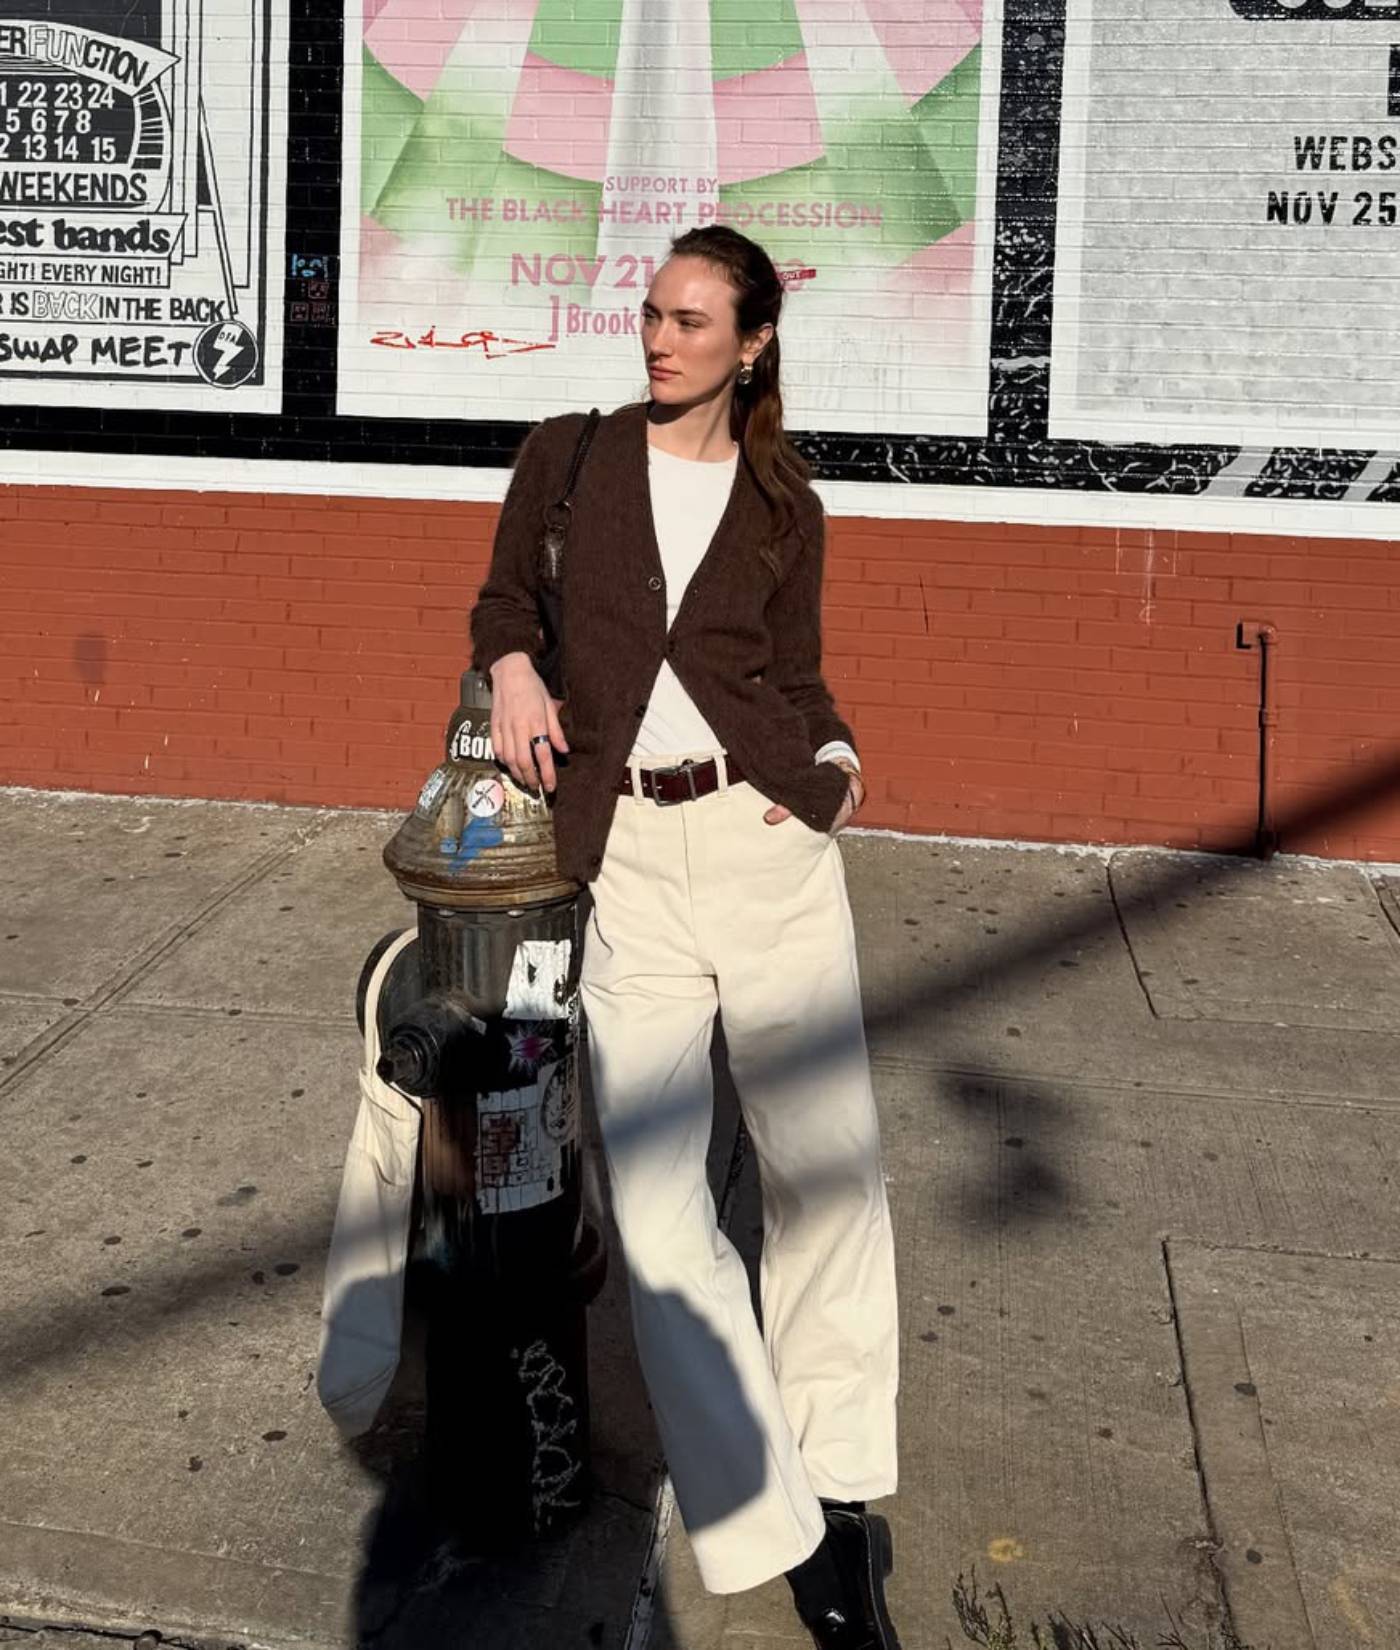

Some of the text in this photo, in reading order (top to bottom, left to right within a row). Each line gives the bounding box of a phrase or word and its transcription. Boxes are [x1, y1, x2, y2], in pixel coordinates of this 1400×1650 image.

[29, 24, 150, 87] FUNCTION
[17, 81, 48, 108] 22
[54, 83, 83, 110] 23
[87, 83, 115, 109] 24
[6, 108, 91, 134] 5 6 7 8
[21, 134, 47, 160] 13
[54, 135, 79, 161] 14
[91, 137, 116, 162] 15
[1294, 135, 1398, 172] WEBS
[0, 171, 148, 202] WEEKENDS
[605, 176, 718, 194] SUPPORT BY
[446, 197, 883, 229] THE BLACK HEART PROCESSION
[1266, 191, 1398, 227] NOV 25
[51, 219, 171, 252] bands
[41, 262, 97, 283] EVERY
[101, 264, 161, 285] NIGHT!
[511, 253, 656, 289] NOV 21
[9, 291, 29, 316] IS
[99, 296, 120, 319] IN
[122, 298, 161, 320] THE
[170, 300, 225, 323] BACK
[566, 303, 645, 335] Brook
[0, 333, 192, 367] SWAP MEET
